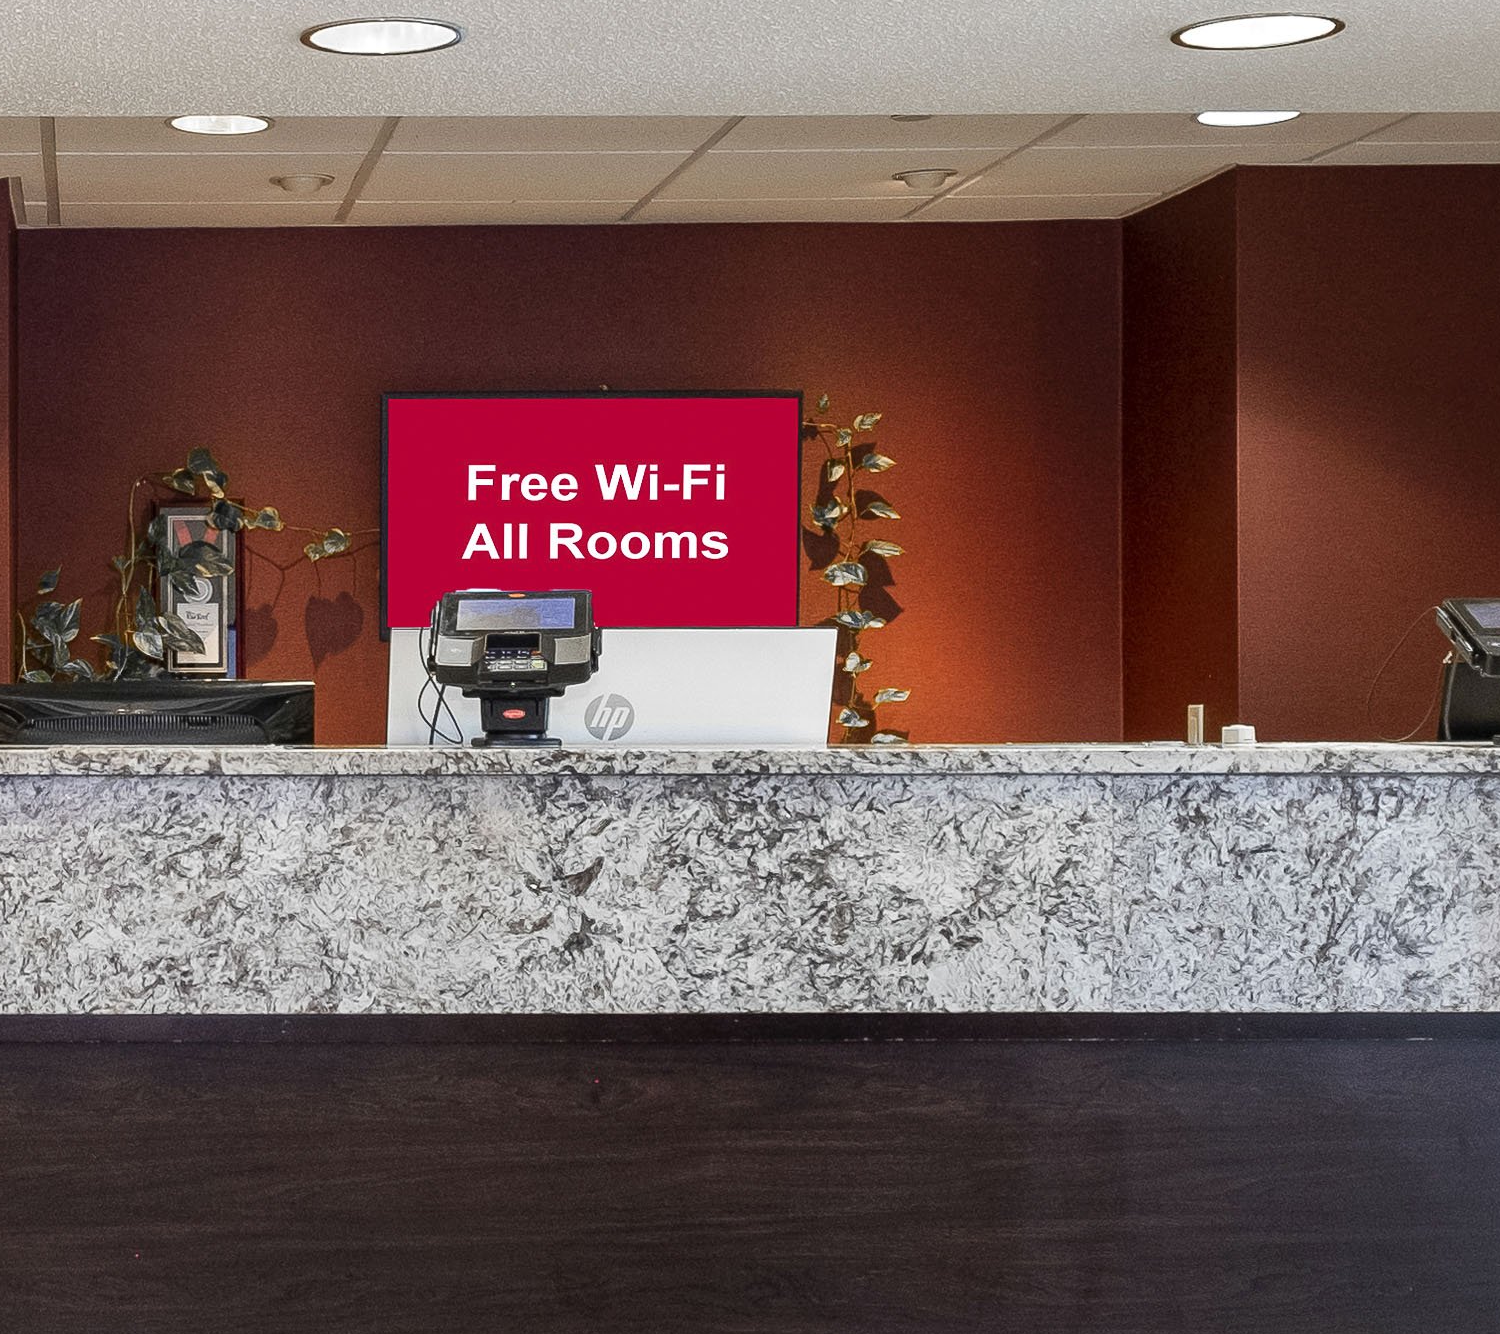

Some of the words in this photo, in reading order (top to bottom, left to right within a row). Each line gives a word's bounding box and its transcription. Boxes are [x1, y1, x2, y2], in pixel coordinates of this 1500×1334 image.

[467, 464, 579, 502] Free
[594, 463, 727, 501] Wi-Fi
[461, 522, 529, 560] All
[549, 522, 730, 560] Rooms
[588, 693, 631, 741] hp
